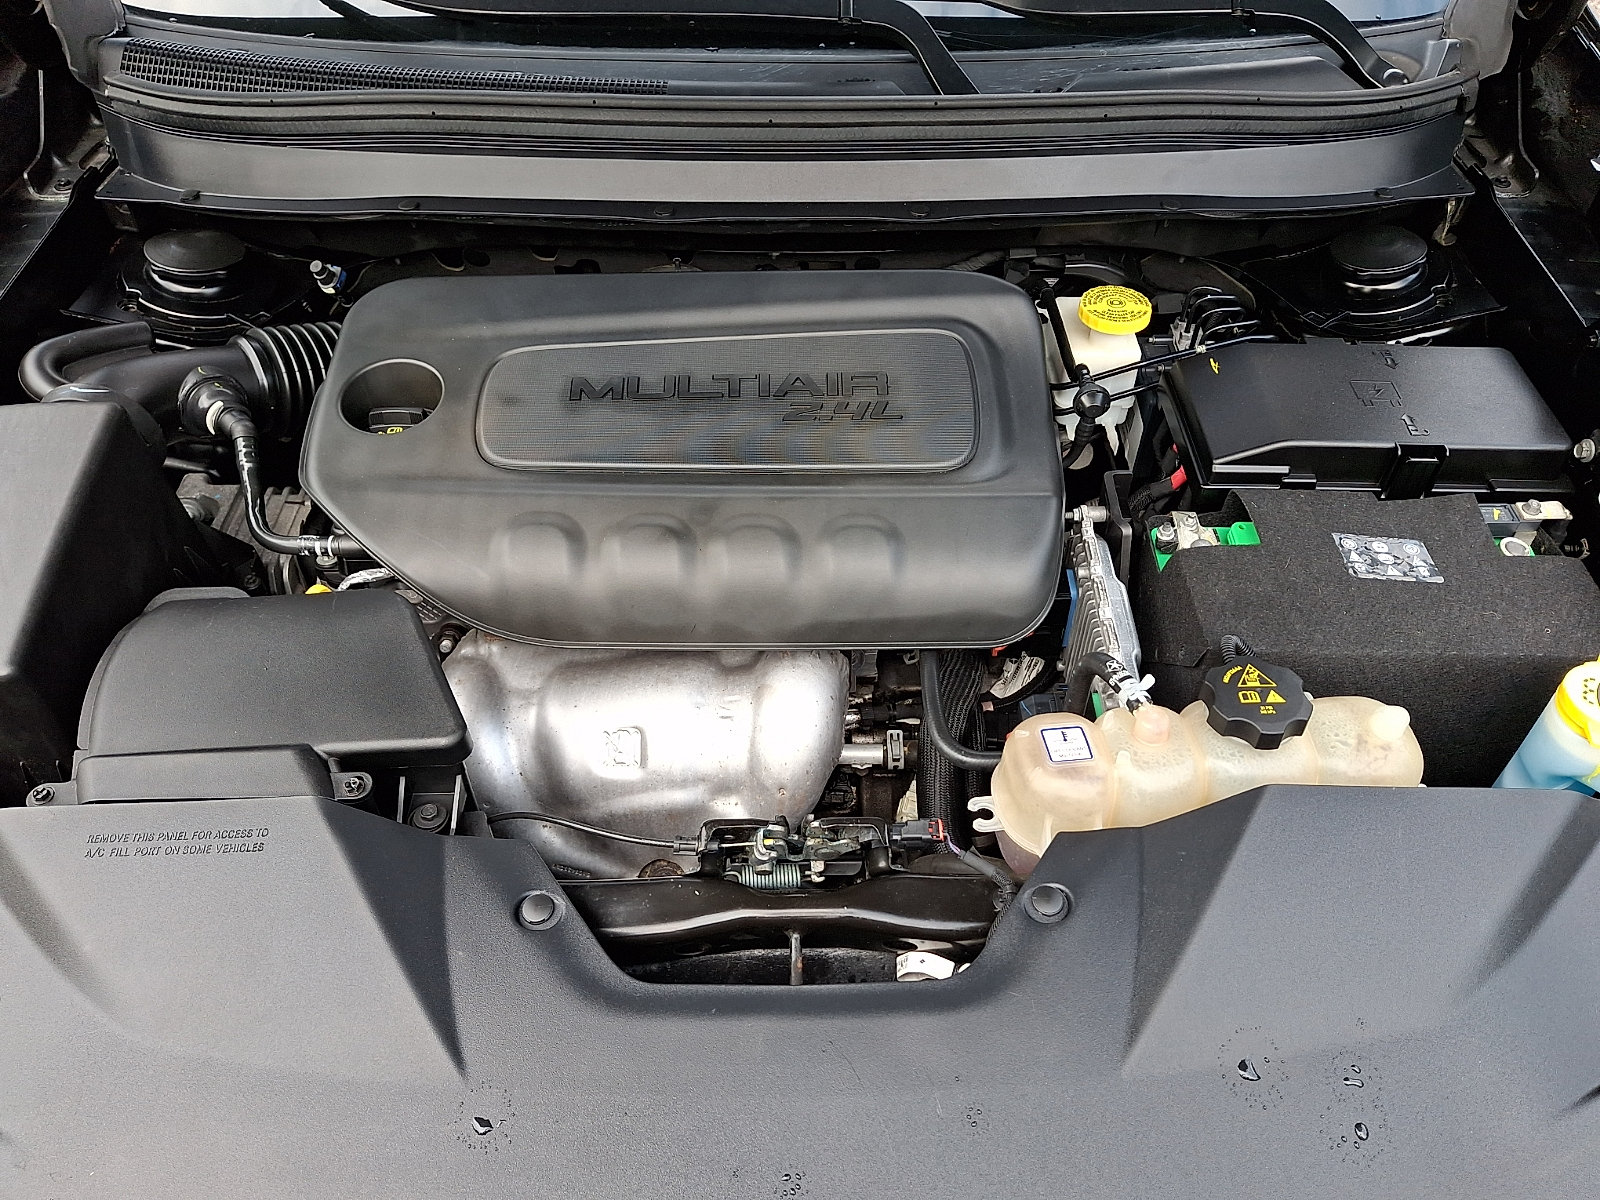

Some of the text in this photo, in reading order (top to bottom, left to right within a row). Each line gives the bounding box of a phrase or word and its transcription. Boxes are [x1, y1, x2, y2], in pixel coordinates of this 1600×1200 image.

[569, 372, 891, 400] MULTIAIR
[782, 400, 904, 421] 2.4L
[86, 827, 270, 844] REMOVE THIS PANEL FOR ACCESS TO
[84, 842, 265, 858] A/C FILL PORT ON SOME VEHICLES
